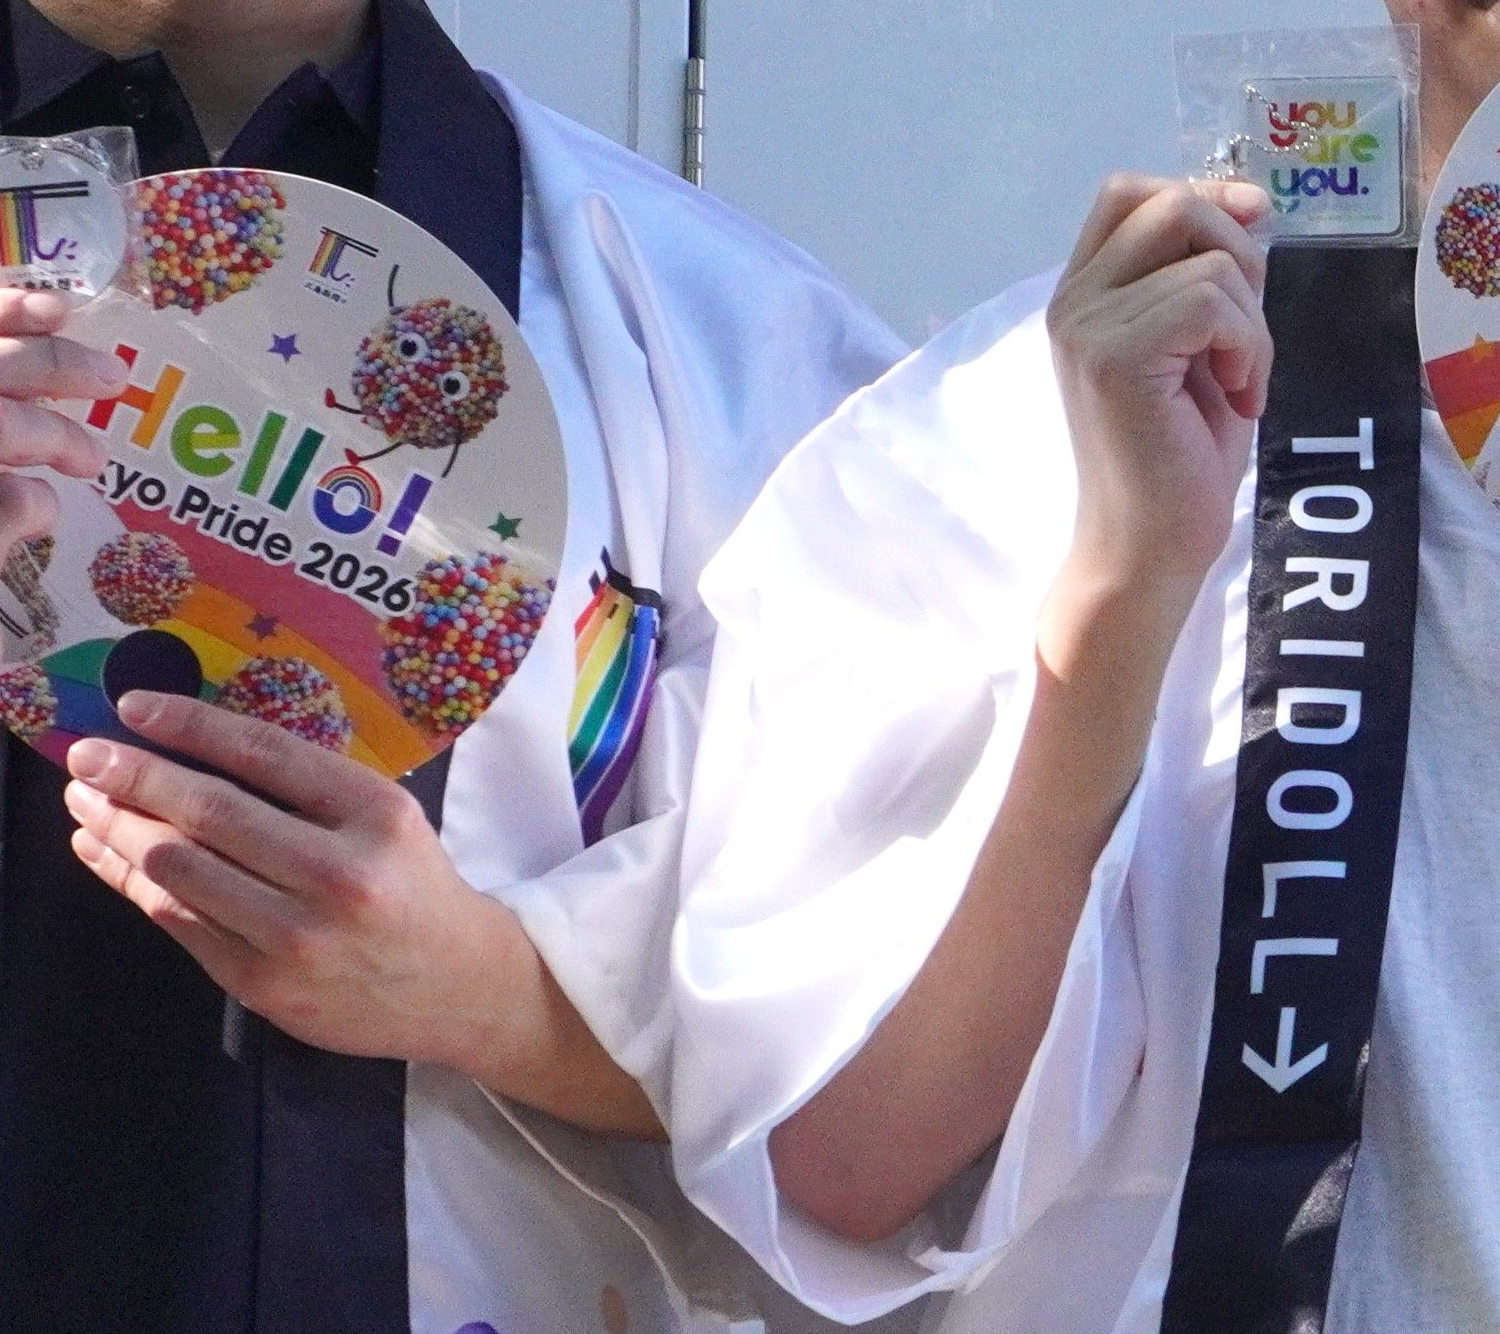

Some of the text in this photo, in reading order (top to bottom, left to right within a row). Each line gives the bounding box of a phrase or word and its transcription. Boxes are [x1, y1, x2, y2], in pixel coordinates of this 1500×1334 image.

[1268, 101, 1357, 147] you
[1303, 133, 1380, 165] are
[1270, 167, 1370, 214] you.
[86, 343, 434, 558] Hello!
[174, 484, 293, 562] Pride
[300, 541, 412, 613] 2026
[1249, 417, 1374, 995] TORIDOLL
